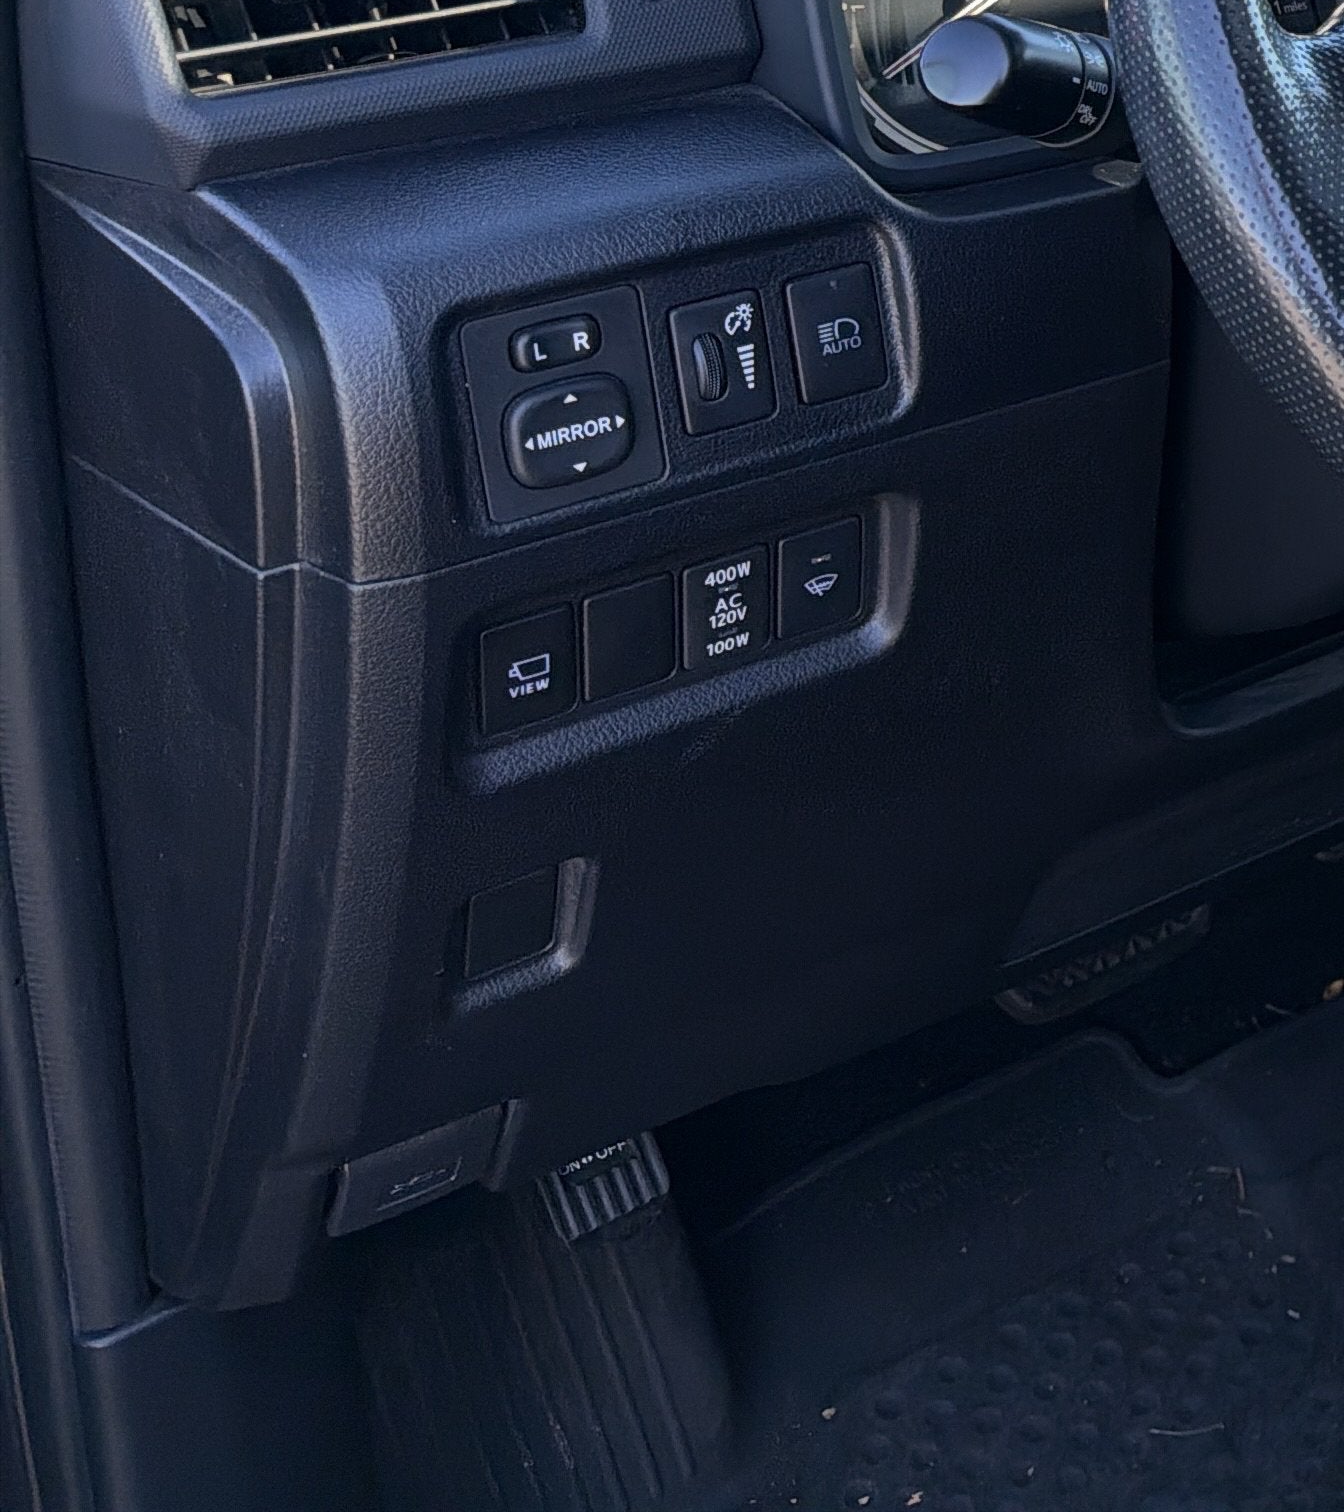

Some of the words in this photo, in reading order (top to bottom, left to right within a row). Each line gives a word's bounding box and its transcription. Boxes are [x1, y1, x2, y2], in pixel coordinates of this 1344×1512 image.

[1086, 79, 1109, 96] AUTO
[534, 342, 547, 361] L
[573, 331, 590, 352] R
[823, 334, 862, 356] AUTO
[536, 416, 612, 451] MIRROR
[705, 561, 751, 587] 400W
[714, 592, 743, 613] AC
[709, 607, 748, 630] 120V
[706, 632, 750, 657] 100W
[509, 677, 550, 699] VIEW
[558, 1159, 581, 1176] ON
